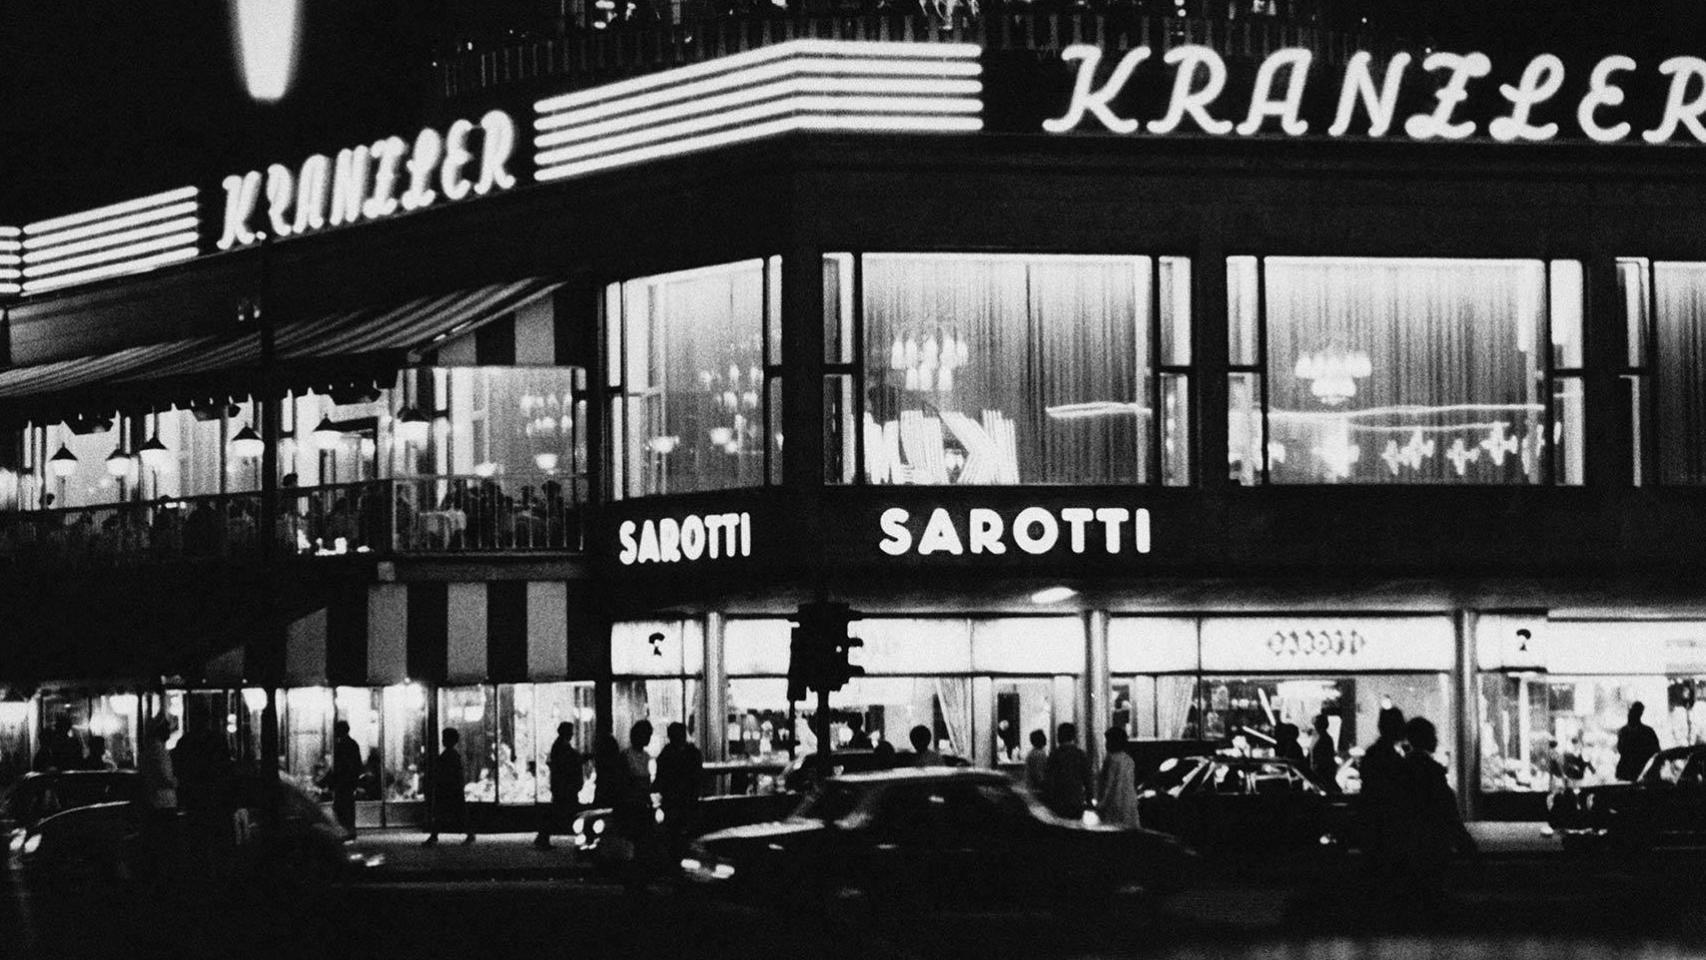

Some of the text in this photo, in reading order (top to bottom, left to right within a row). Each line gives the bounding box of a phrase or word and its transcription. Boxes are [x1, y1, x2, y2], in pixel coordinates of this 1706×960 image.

[1042, 44, 1706, 144] KRANZLER
[217, 106, 516, 250] KRANZLER
[619, 512, 751, 565] SAROTTI
[879, 507, 1151, 555] SAROTTI
